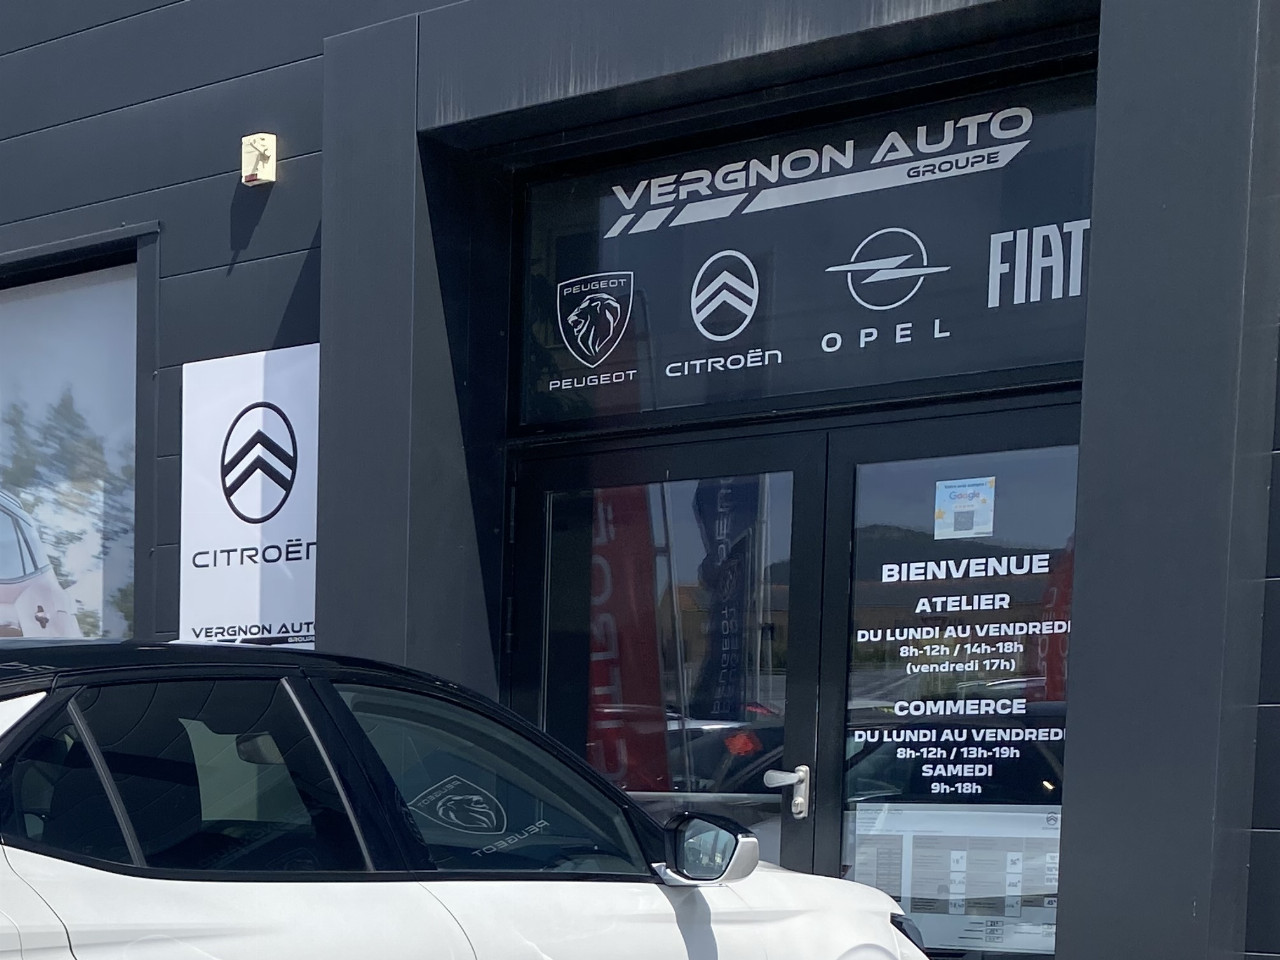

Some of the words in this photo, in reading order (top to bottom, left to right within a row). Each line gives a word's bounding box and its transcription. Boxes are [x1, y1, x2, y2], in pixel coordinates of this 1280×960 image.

[611, 140, 855, 211] VERGNON
[870, 106, 1034, 164] AUTO
[907, 150, 1001, 179] GROUPE
[987, 218, 1091, 308] FIAT
[563, 278, 627, 296] PEUGEOT
[821, 318, 951, 353] OPEL
[549, 369, 638, 391] PEUGEOT
[882, 553, 1050, 583] BIENVENUE
[915, 593, 1010, 614] ATELIER
[191, 623, 272, 639] VERGNON
[277, 621, 315, 634] AUT
[857, 629, 882, 642] DU
[886, 626, 940, 641] LUNDI
[944, 624, 971, 639] AU
[975, 620, 1071, 637] VENDREDI
[899, 643, 950, 658] 8h-12h
[964, 641, 1024, 656] 14h-18h
[906, 659, 979, 675] (vendredi
[982, 659, 1016, 673] 17h)
[894, 698, 1027, 716] COMMERCE
[854, 730, 879, 743] DU
[883, 729, 936, 742] LUNDI
[940, 728, 967, 742] AU
[896, 747, 947, 759] 8h-12h
[960, 746, 1020, 759] 13h-19h
[921, 764, 993, 777] SAMEDI
[931, 782, 982, 794] 9h-18h
